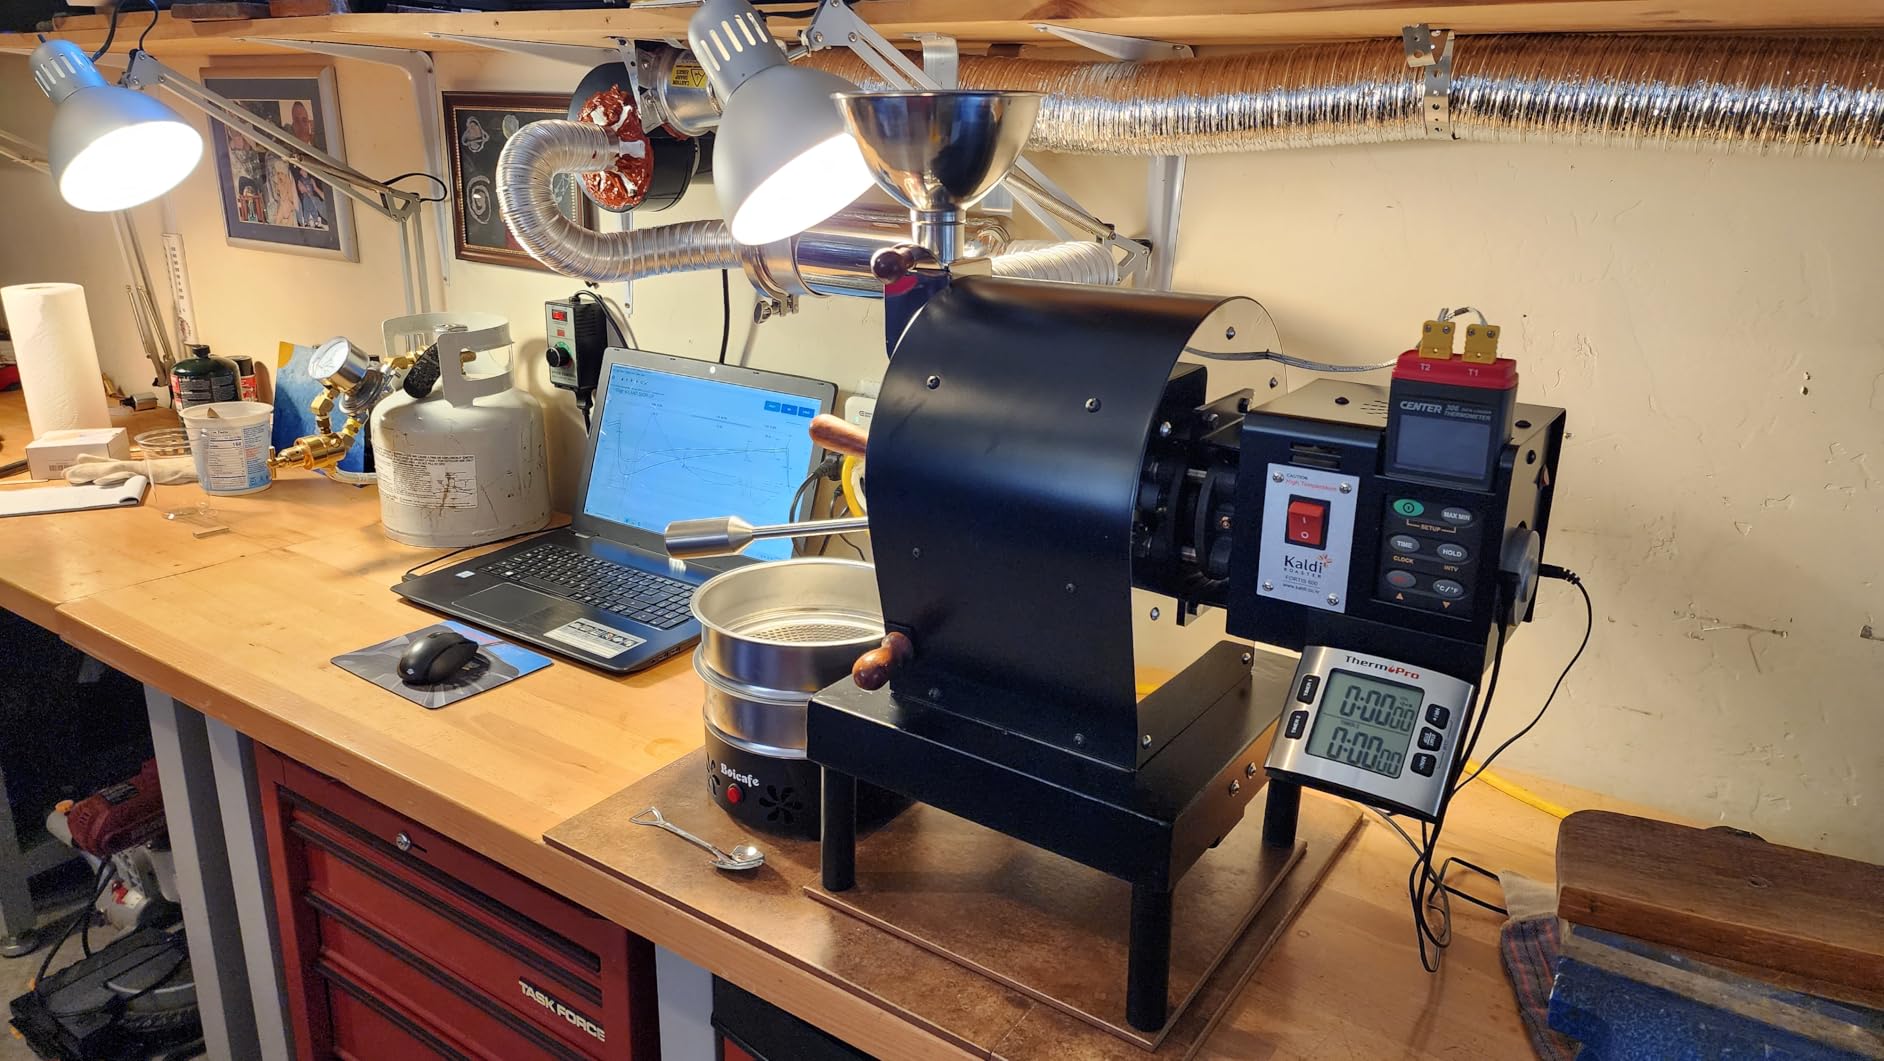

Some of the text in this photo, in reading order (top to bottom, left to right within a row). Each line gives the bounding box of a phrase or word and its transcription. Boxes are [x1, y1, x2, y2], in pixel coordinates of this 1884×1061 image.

[1420, 363, 1431, 371] T2
[1468, 368, 1479, 377] T1
[1400, 400, 1442, 414] CENTER
[1443, 410, 1491, 421] THERMOMETER
[1286, 473, 1309, 481] CAUTION
[1443, 511, 1471, 521] MAX MIN
[1420, 523, 1441, 532] SETUP
[1396, 540, 1413, 549] TIME
[1442, 549, 1462, 558] HOLD
[1284, 555, 1323, 574] Kaldi
[1392, 555, 1415, 565] CLOCK
[1283, 567, 1322, 579] ROASTER
[1345, 655, 1421, 680] ThermoPro
[720, 762, 760, 788] Boicafe
[518, 980, 606, 1043] TASK FORCE
